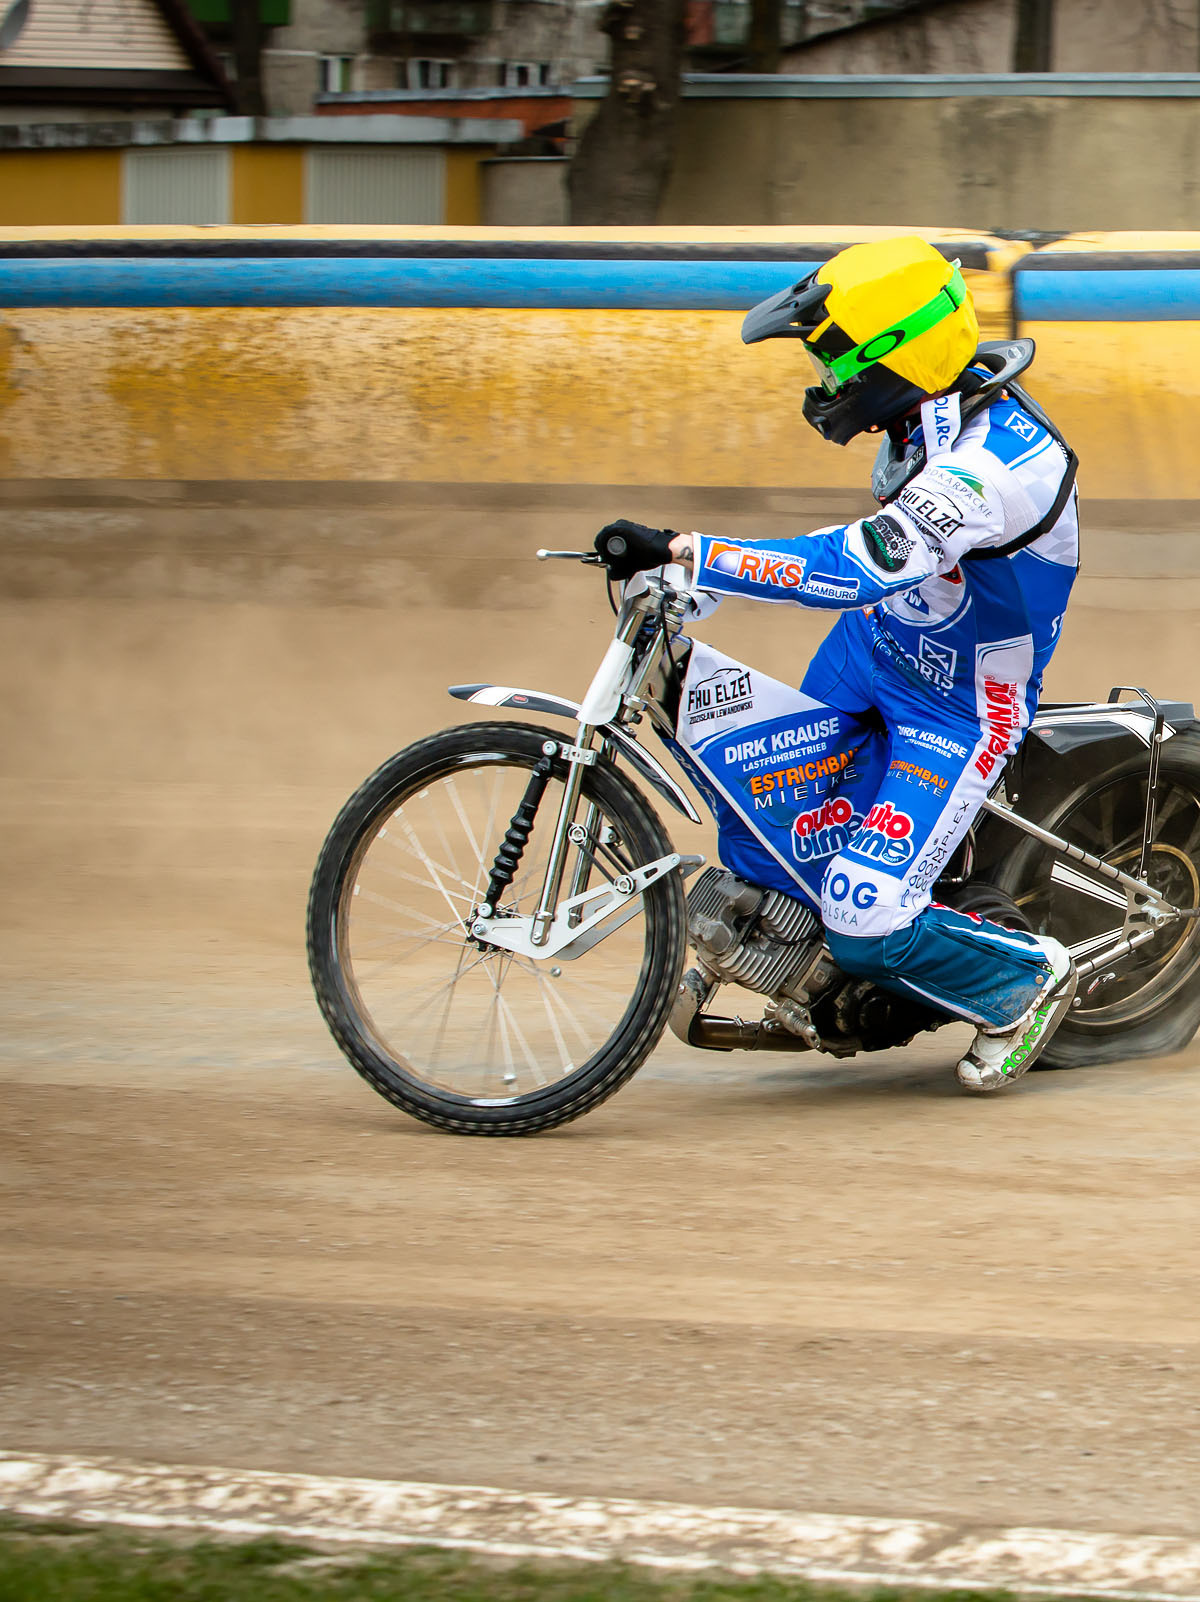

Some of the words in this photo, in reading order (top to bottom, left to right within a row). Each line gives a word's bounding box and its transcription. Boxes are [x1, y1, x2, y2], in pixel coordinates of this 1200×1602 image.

[923, 468, 993, 519] ODKARPACKIE
[915, 499, 966, 538] ELZET
[806, 584, 857, 600] HAMBURG
[687, 689, 711, 712] FHU
[714, 671, 753, 704] ELZET
[716, 700, 753, 718] LEWANDOWSKI
[724, 736, 767, 765] DIRK
[771, 716, 840, 753] KRAUSE
[742, 741, 827, 772] LASTFUHRBETRIEB
[918, 730, 968, 758] KRAUSE
[974, 750, 996, 780] JB
[754, 764, 858, 810] MIELKE
[796, 799, 852, 837] auto
[862, 803, 911, 839] uto
[850, 829, 911, 863] rne
[821, 900, 858, 927] OLSKA
